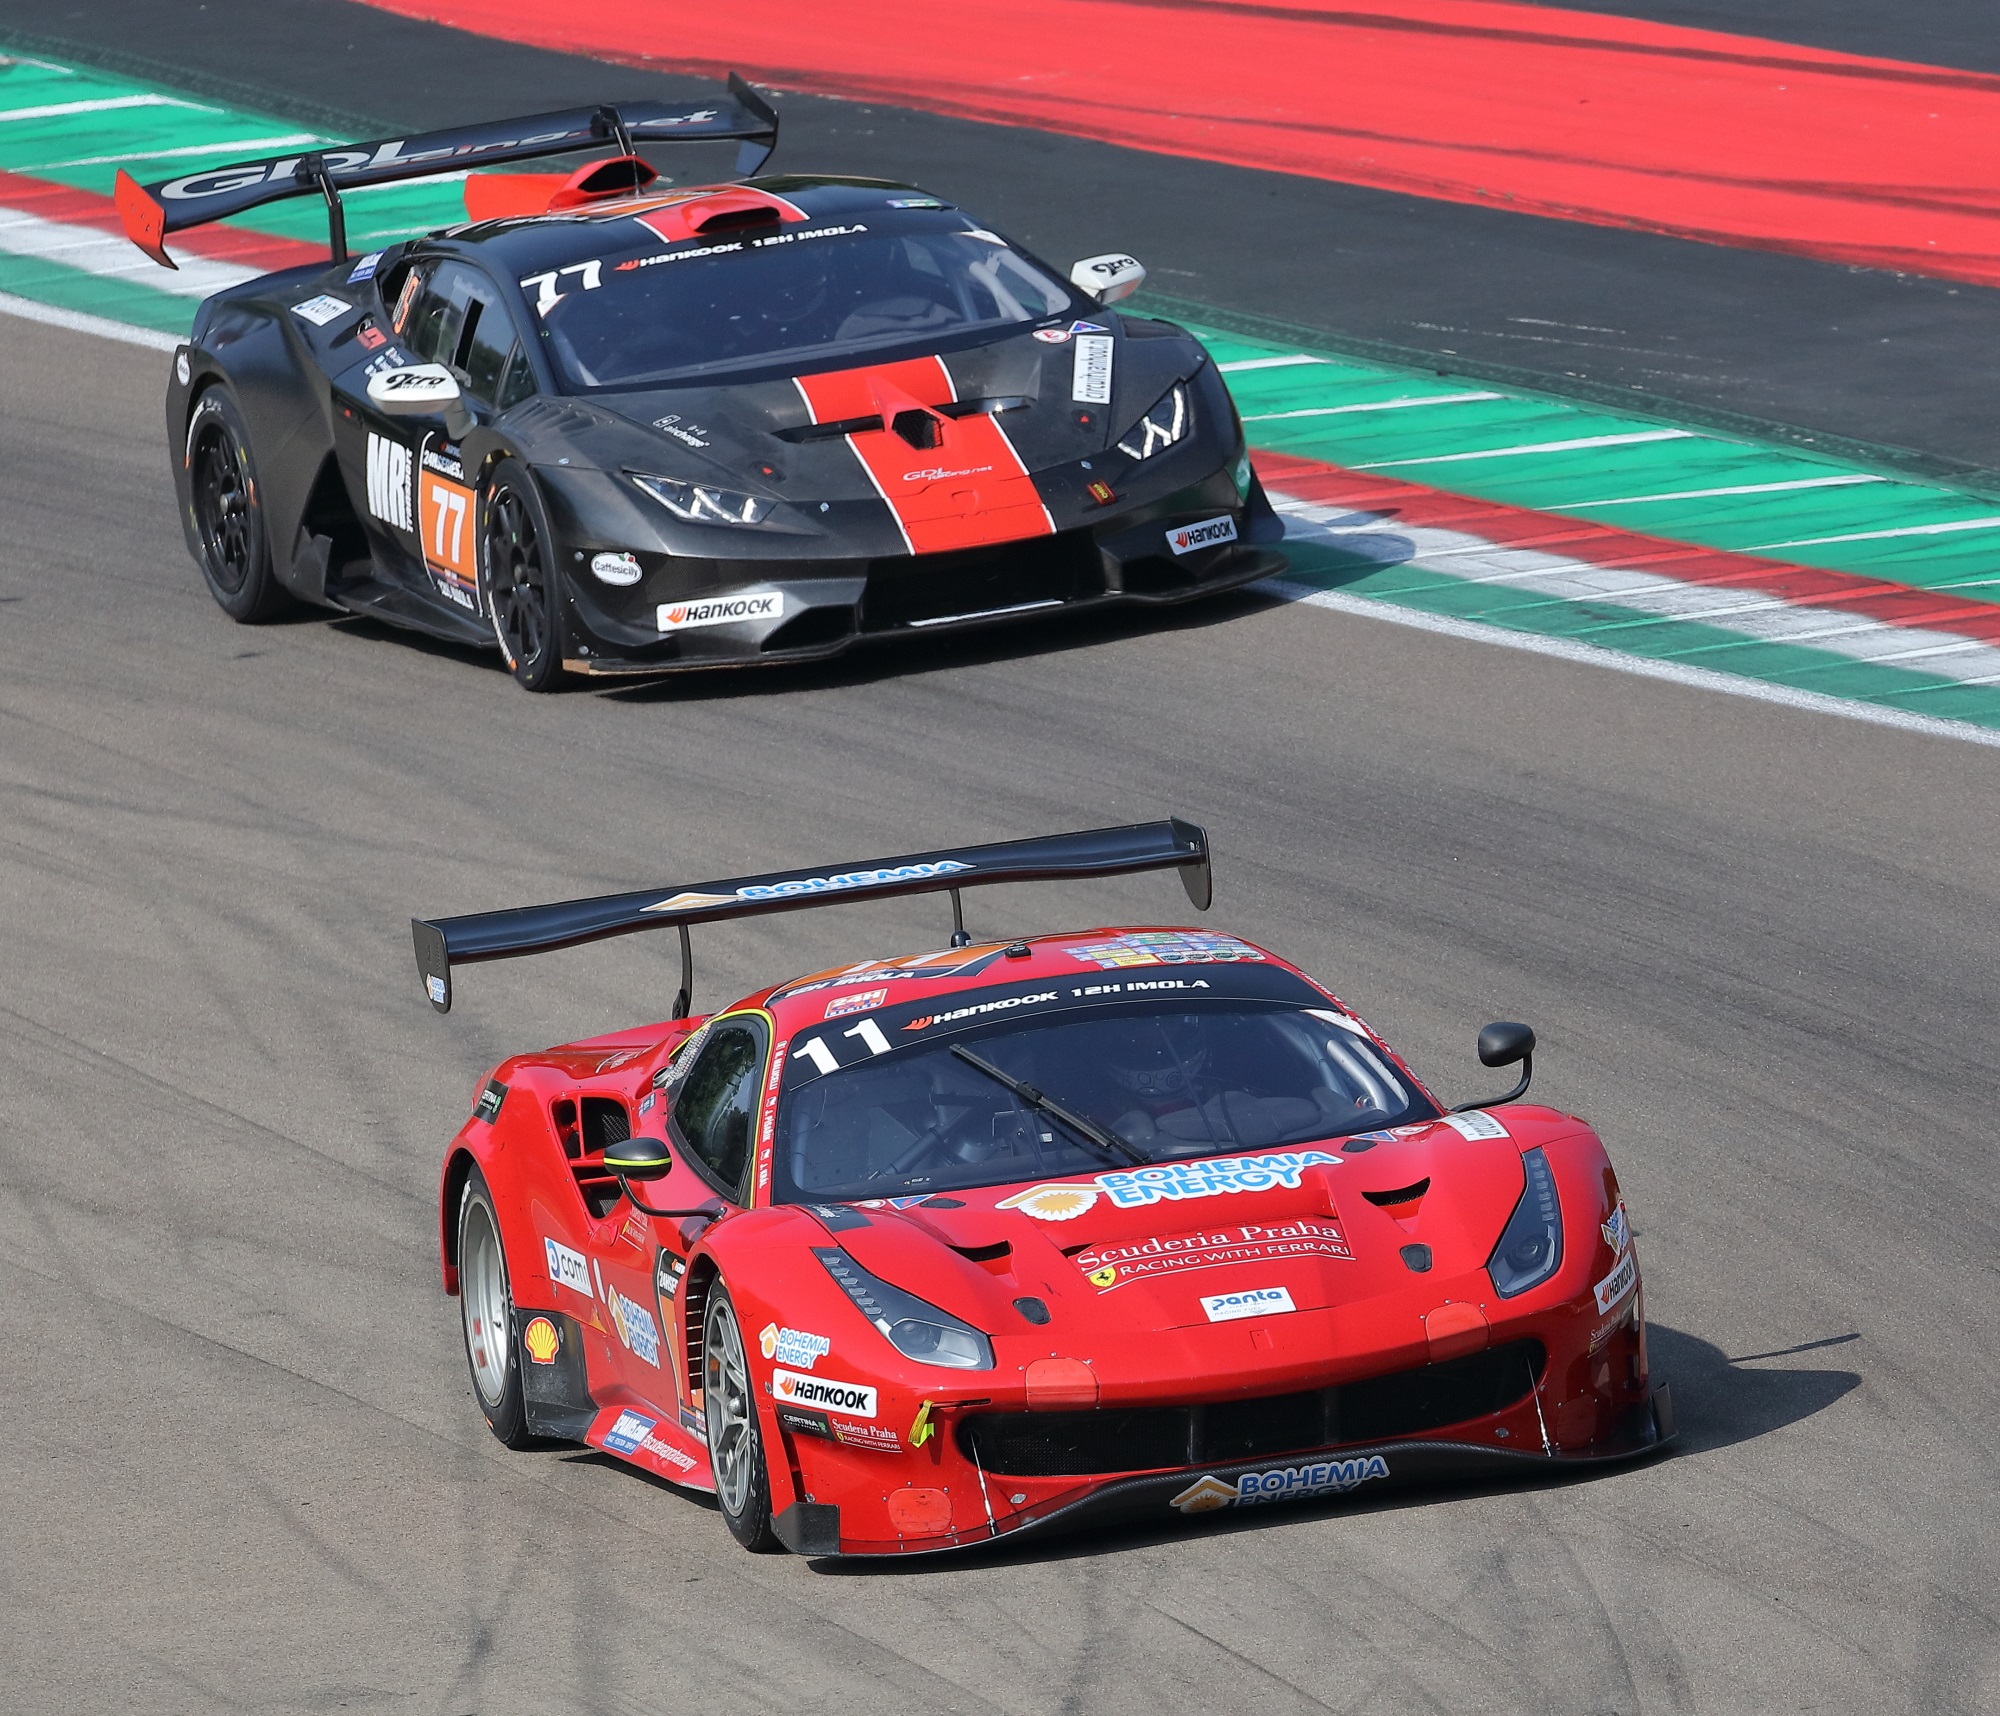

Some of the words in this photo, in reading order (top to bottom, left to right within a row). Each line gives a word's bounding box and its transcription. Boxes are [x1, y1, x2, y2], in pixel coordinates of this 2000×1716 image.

[751, 234, 794, 248] 12H
[797, 224, 868, 241] IMOLA
[520, 260, 602, 309] 77
[366, 431, 406, 530] MR
[432, 485, 466, 564] 77
[743, 861, 960, 897] BOHEMIA
[832, 989, 881, 1006] 24H
[1071, 984, 1121, 998] 12H
[1127, 979, 1210, 993] IMOLA
[792, 1018, 893, 1075] 11
[1100, 1151, 1338, 1189] BOHEMIA
[1113, 1166, 1302, 1204] ENERGY
[1077, 1231, 1231, 1272] Scuderia
[1237, 1220, 1342, 1241] Praha
[1120, 1254, 1201, 1277] RACING
[1204, 1247, 1261, 1262] WITH
[1267, 1241, 1350, 1256] FERRARI
[1212, 1290, 1283, 1311] panta
[776, 1345, 817, 1368] ENERGY
[779, 1329, 829, 1354] BOHEMIA
[831, 1418, 868, 1436] Scuderia
[869, 1425, 898, 1440] Praha
[1241, 1458, 1387, 1496] BOHEMIA
